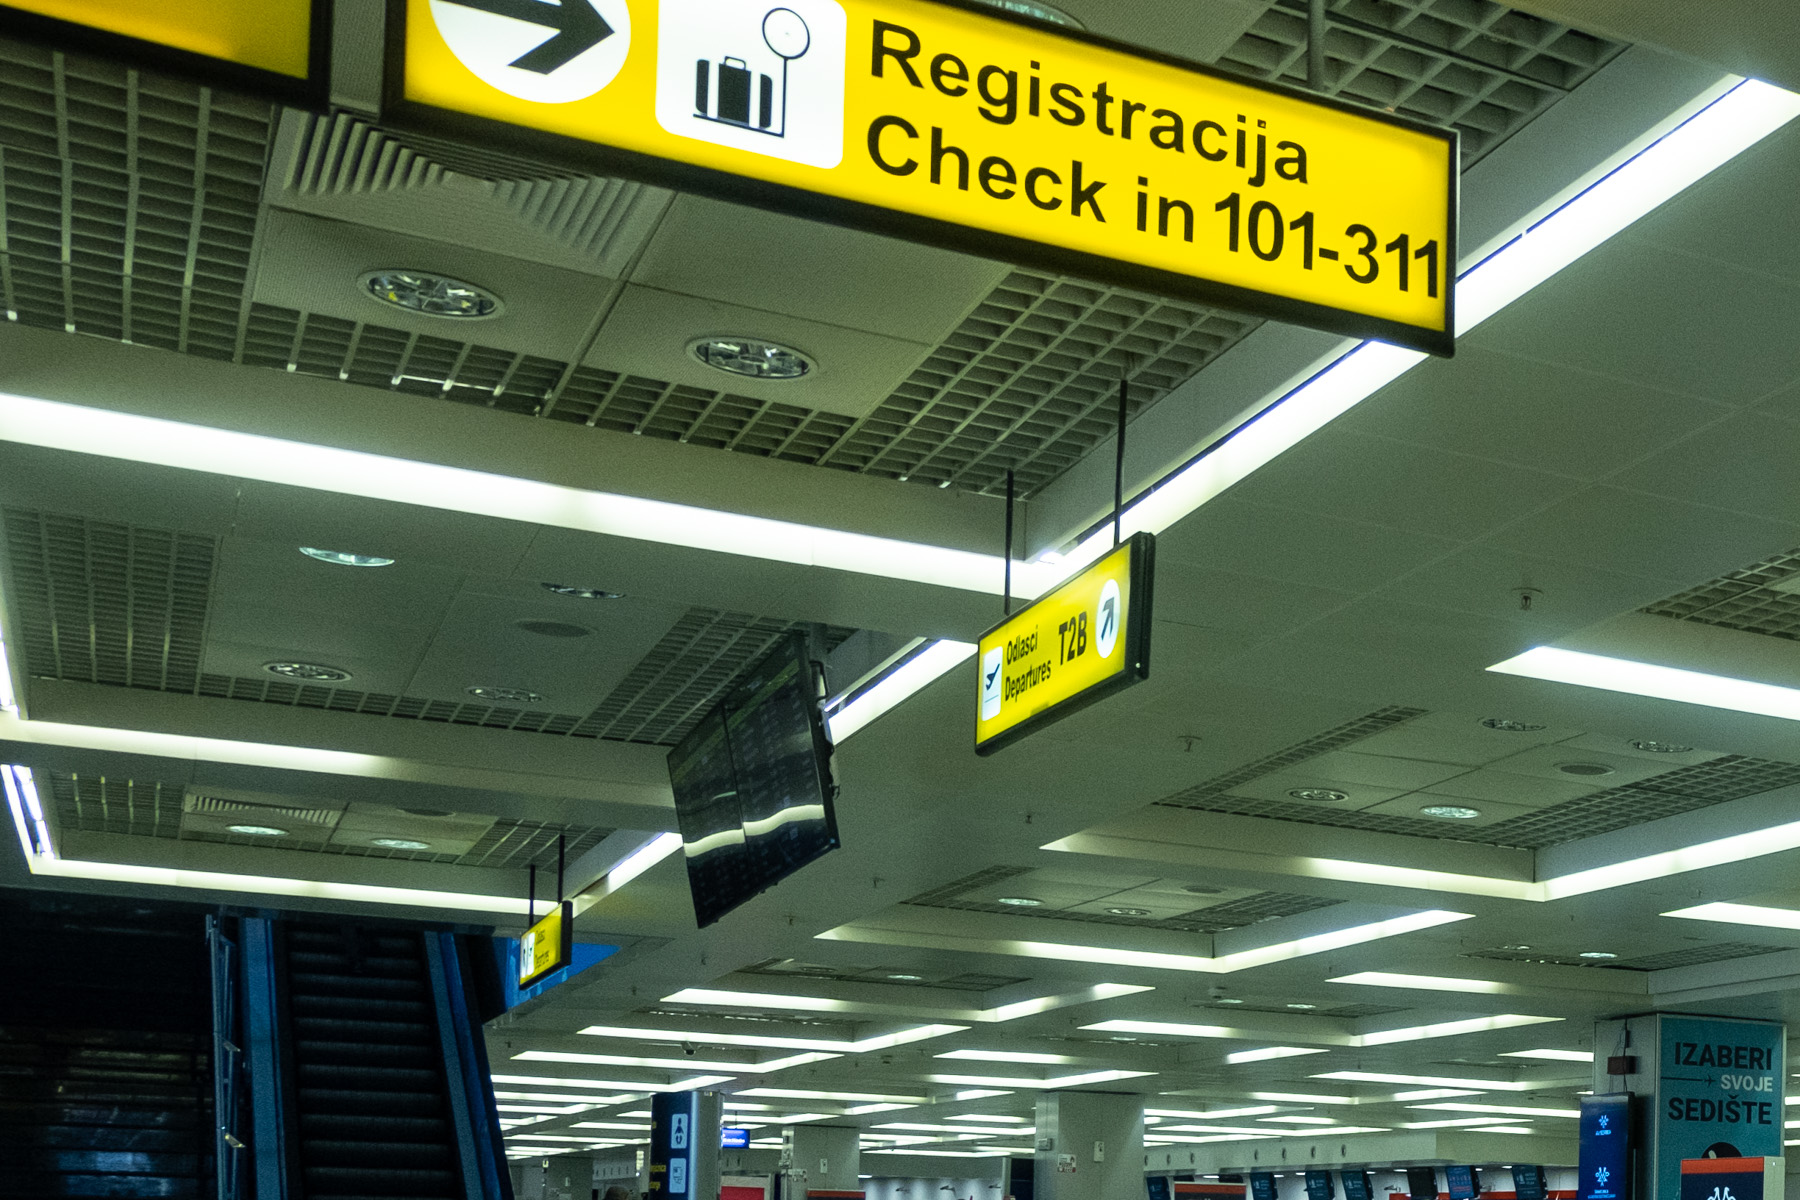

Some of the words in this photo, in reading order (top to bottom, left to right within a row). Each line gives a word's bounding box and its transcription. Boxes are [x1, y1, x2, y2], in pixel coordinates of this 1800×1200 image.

[869, 18, 1309, 188] Registracija
[866, 114, 1107, 224] Check
[1135, 176, 1196, 244] in
[1213, 191, 1440, 299] 101-311
[1006, 624, 1039, 666] Odlasci
[1058, 611, 1088, 666] T2B
[1005, 659, 1052, 703] Departures
[1674, 1042, 1773, 1070] IZABERI
[1720, 1074, 1773, 1092] SVOJE
[1668, 1094, 1773, 1125] SEDIŠTE
